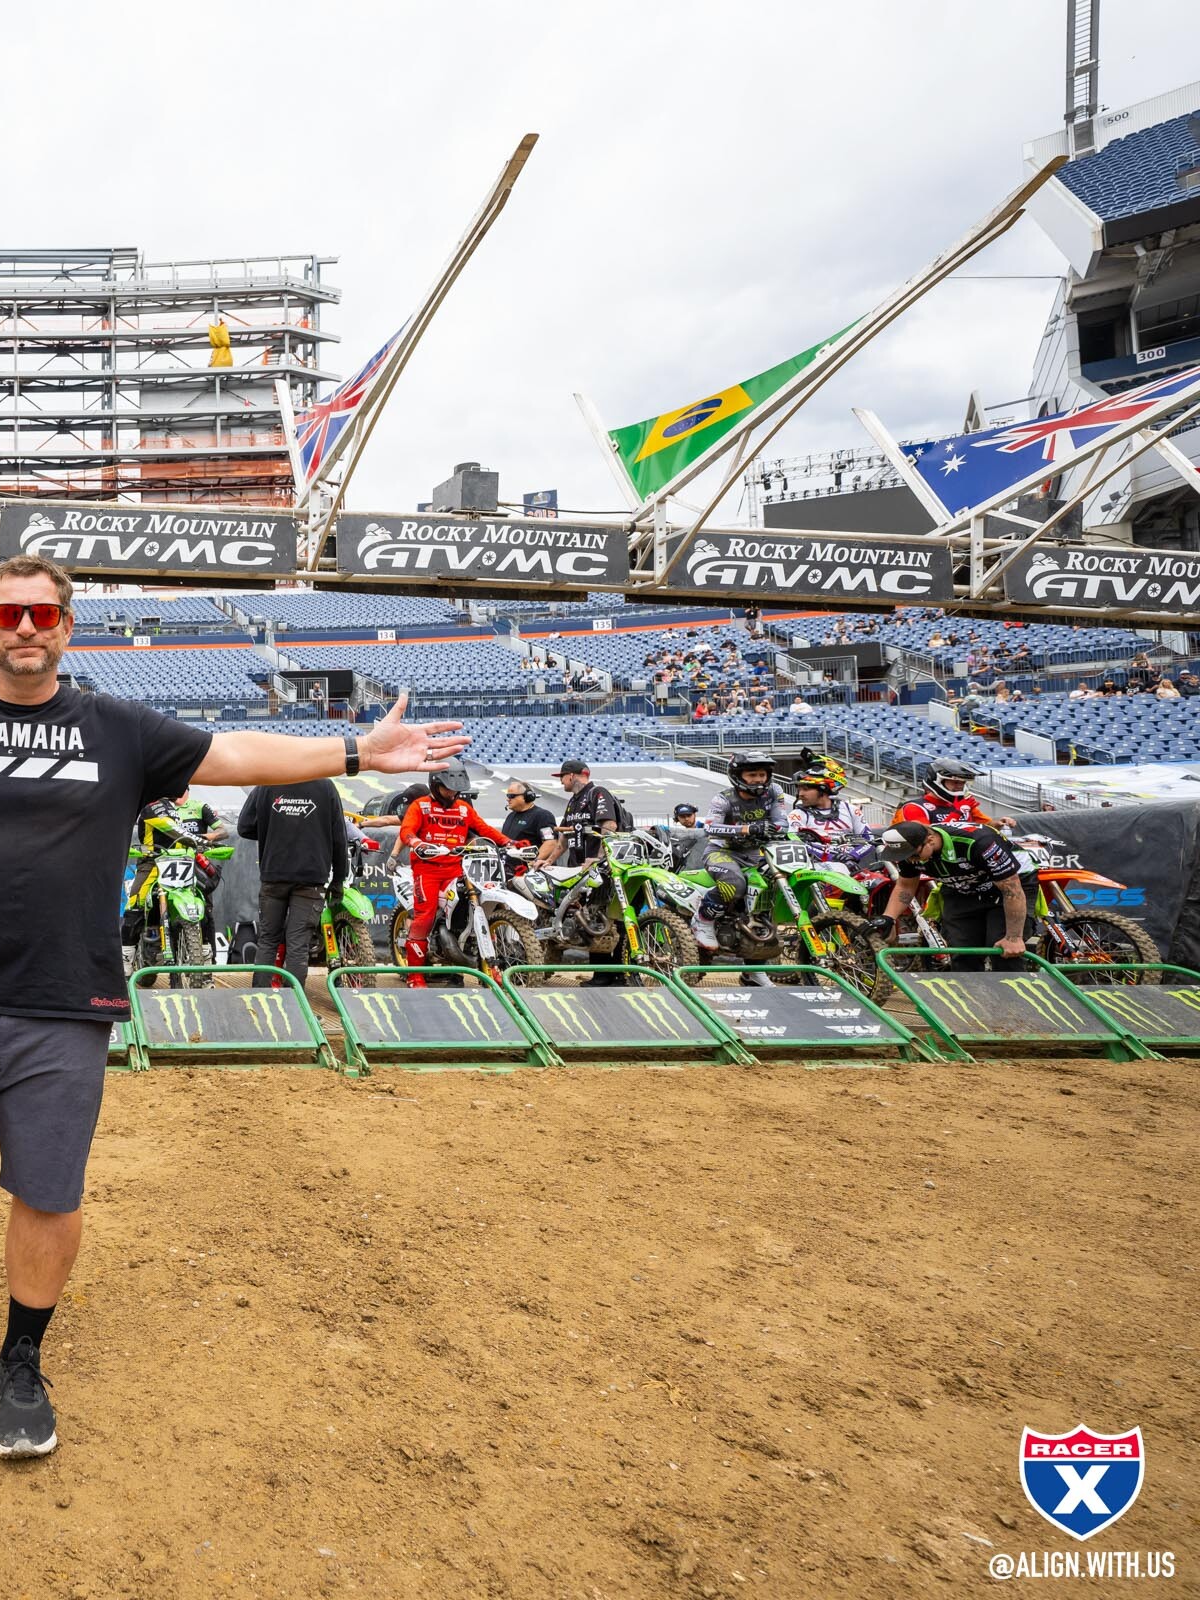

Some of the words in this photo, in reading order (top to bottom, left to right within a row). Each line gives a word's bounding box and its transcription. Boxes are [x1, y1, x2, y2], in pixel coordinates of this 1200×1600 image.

[1107, 111, 1129, 125] 500
[1138, 348, 1165, 362] 300
[60, 511, 142, 533] ROCKY
[143, 514, 277, 539] MOUNTAIN
[397, 521, 480, 543] ROCKY
[480, 524, 608, 550] MOUNTAIN
[725, 538, 804, 560] ROCKY
[806, 542, 933, 568] MOUNTAIN
[1064, 551, 1142, 574] ROCKY
[594, 619, 612, 630] 135
[134, 636, 150, 646] 133
[378, 630, 395, 641] 134
[775, 845, 808, 865] 68
[161, 861, 193, 881] 47
[468, 859, 503, 882] 412
